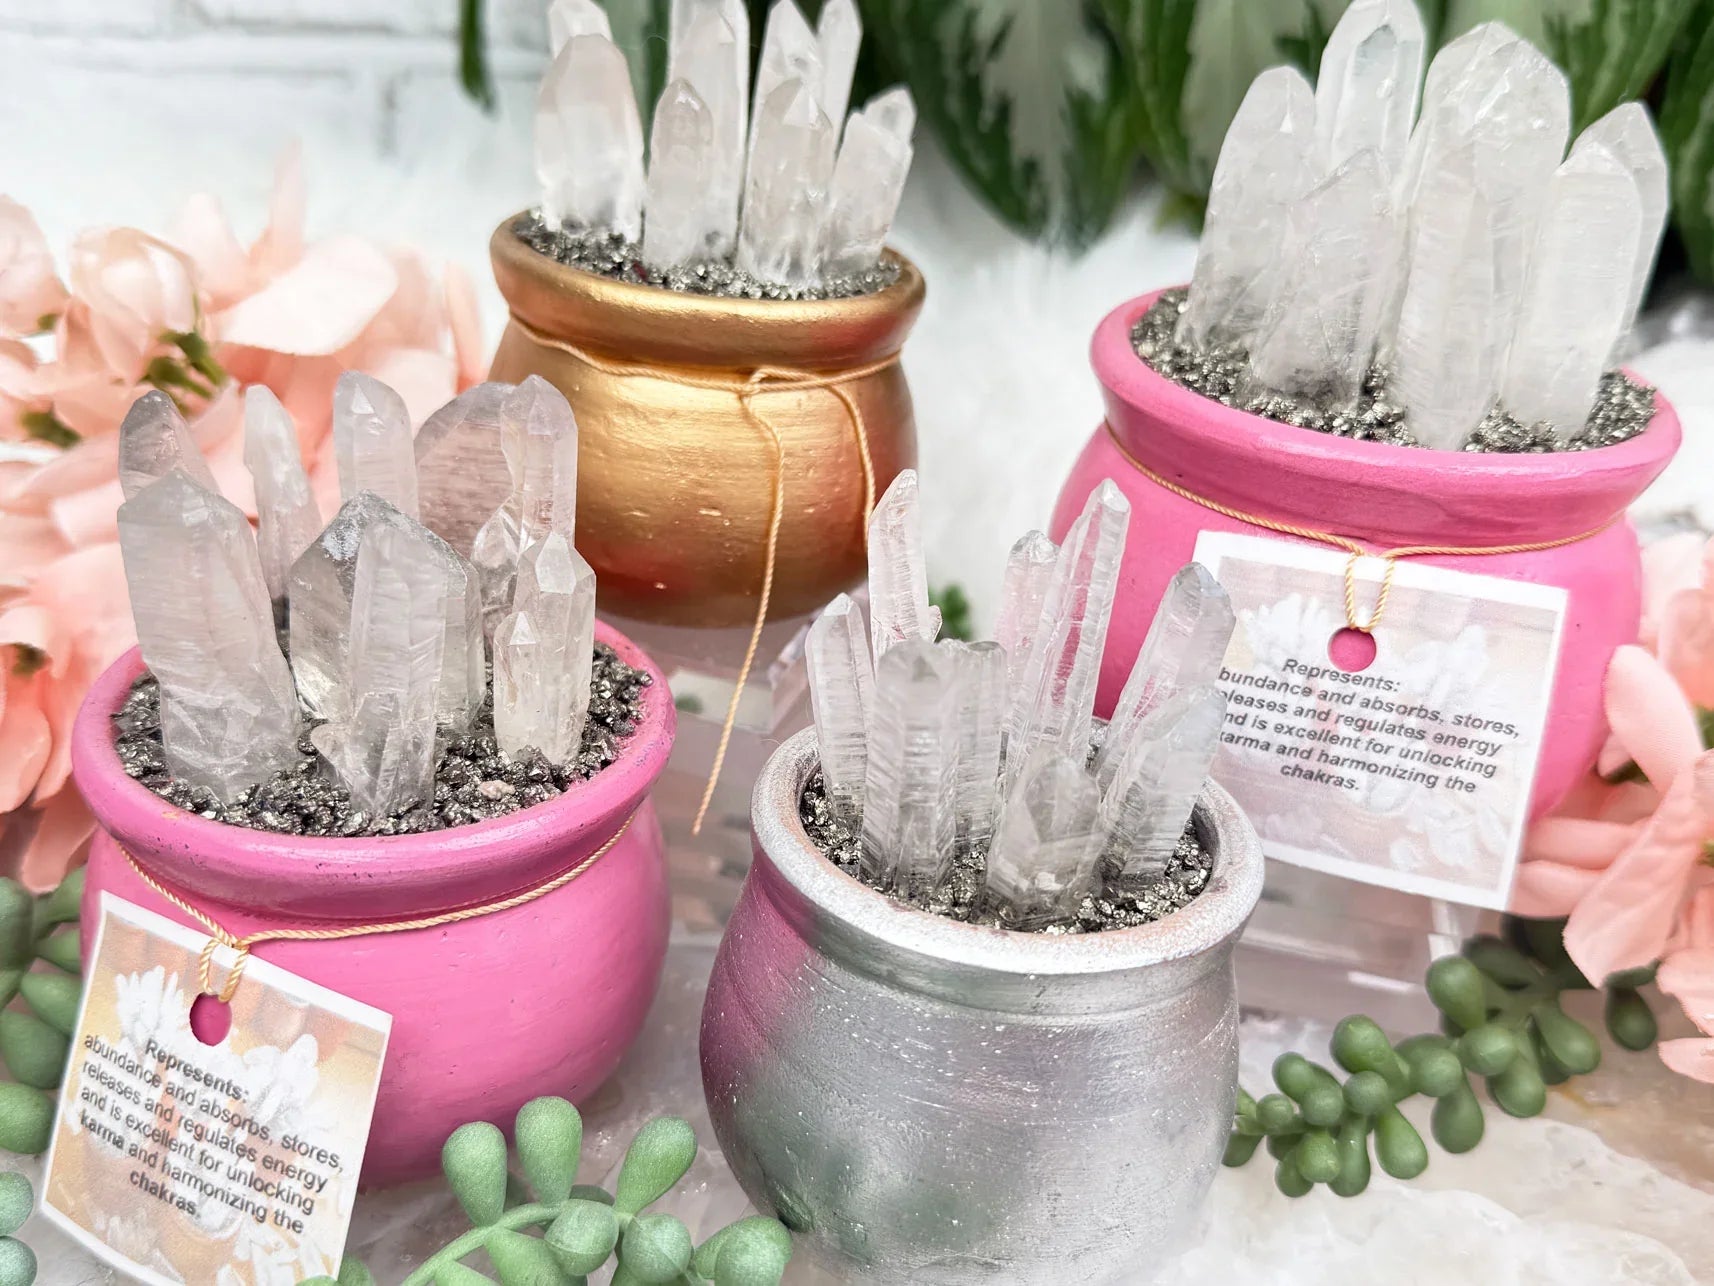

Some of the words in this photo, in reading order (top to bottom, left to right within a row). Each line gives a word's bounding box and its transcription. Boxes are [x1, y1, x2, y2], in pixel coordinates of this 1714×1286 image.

[1218, 667, 1313, 698] bundance
[1318, 688, 1354, 706] and
[1359, 695, 1444, 724] absorbs,
[1452, 713, 1519, 739] stores,
[1282, 658, 1400, 692] Represents:
[1220, 691, 1287, 714] leases
[1293, 706, 1329, 722] and
[1334, 713, 1425, 741] regulates
[1433, 732, 1502, 758] energy
[1225, 713, 1247, 727] nd
[1251, 715, 1267, 729] is
[1274, 722, 1359, 751] excellent
[1364, 739, 1393, 756] for
[1398, 748, 1497, 779] unlocking
[1275, 742, 1312, 760] and
[1318, 748, 1439, 789] harmonizing
[1446, 775, 1476, 793] the
[1280, 764, 1359, 790] chakras.
[84, 1034, 162, 1088] abundance
[166, 1081, 196, 1106] and
[199, 1098, 272, 1146] absorbs,
[281, 1133, 343, 1173] stores,
[146, 1039, 248, 1103] Represents:
[81, 1086, 106, 1112] and
[110, 1100, 121, 1120] is
[126, 1116, 194, 1161] excellent
[199, 1149, 222, 1173] for
[226, 1166, 315, 1215] unlocking
[82, 1060, 141, 1104] releases
[144, 1097, 173, 1122] and
[177, 1116, 256, 1161] regulates
[262, 1155, 328, 1192] energy
[80, 1109, 126, 1150] karma
[128, 1142, 158, 1168] and
[161, 1159, 268, 1223] harmonizing
[273, 1208, 304, 1233] the
[130, 1170, 201, 1219] chakras.
